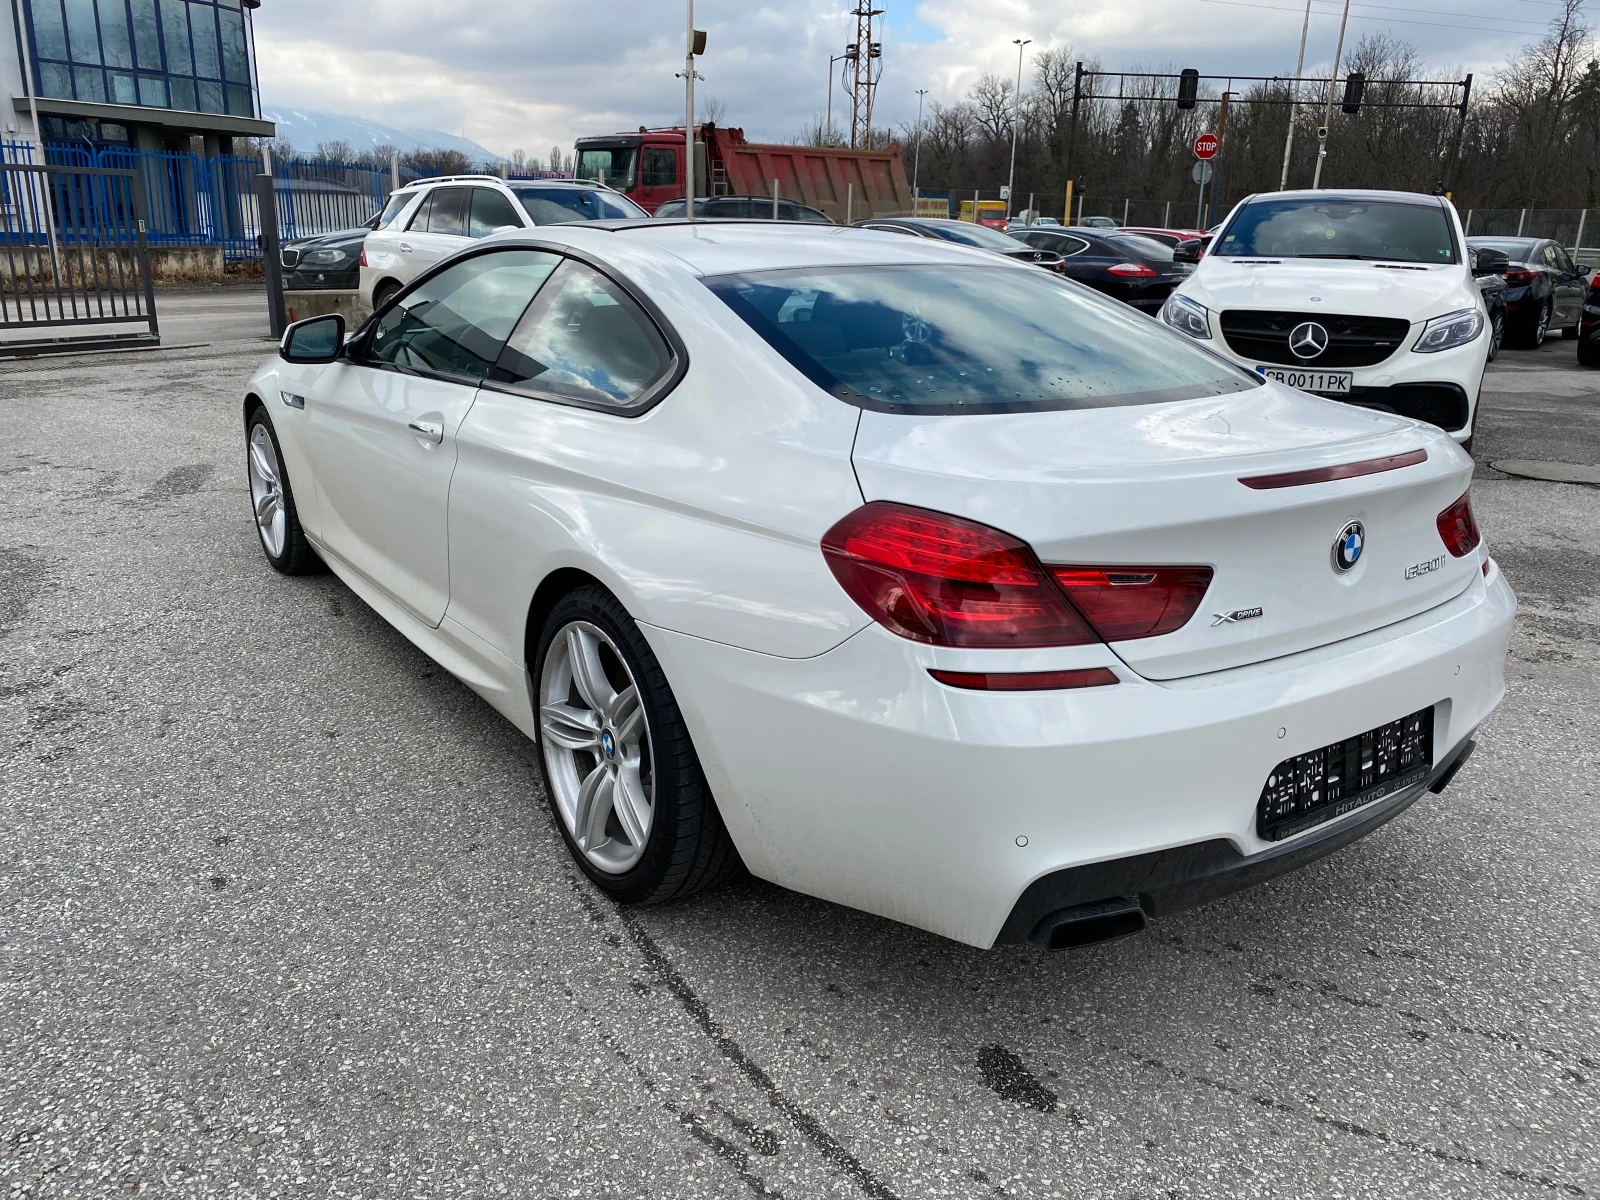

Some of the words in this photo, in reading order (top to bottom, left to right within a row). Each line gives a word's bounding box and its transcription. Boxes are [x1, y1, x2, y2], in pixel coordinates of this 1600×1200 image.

[1197, 141, 1217, 152] STOP
[1287, 373, 1325, 389] 0011
[1327, 375, 1348, 390] PK
